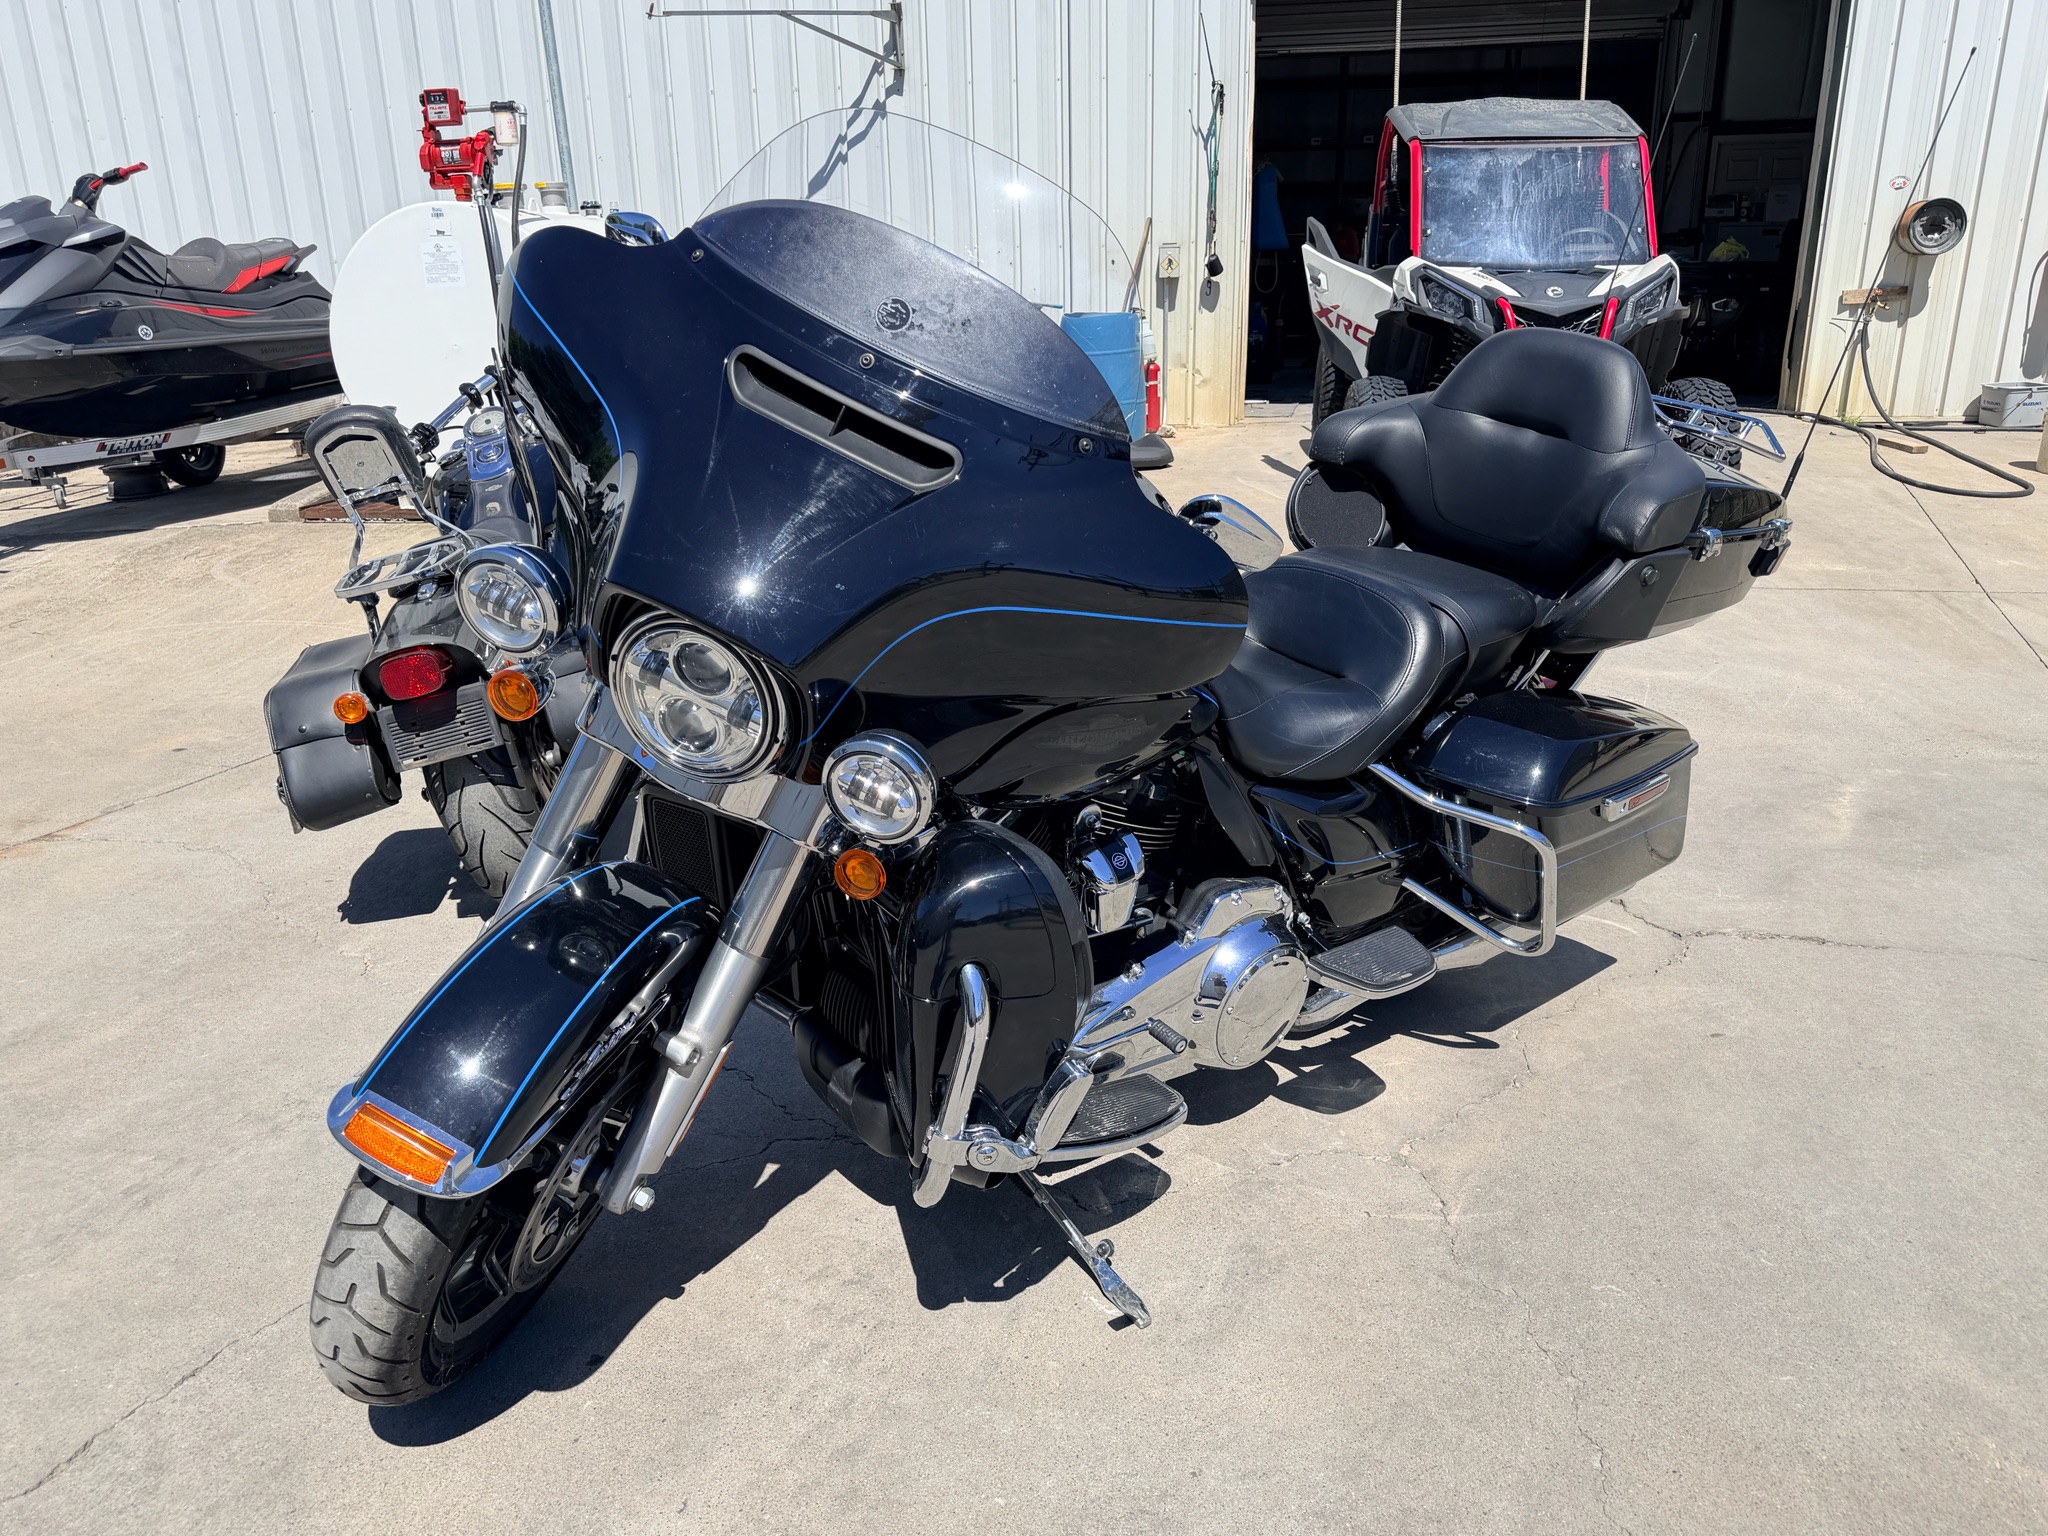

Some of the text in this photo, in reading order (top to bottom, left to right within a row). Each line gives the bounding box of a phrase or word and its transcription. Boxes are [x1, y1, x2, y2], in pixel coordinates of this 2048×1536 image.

[1315, 300, 1375, 347] XRC
[105, 434, 165, 451] TRITON
[116, 444, 157, 454] TRAILERS
